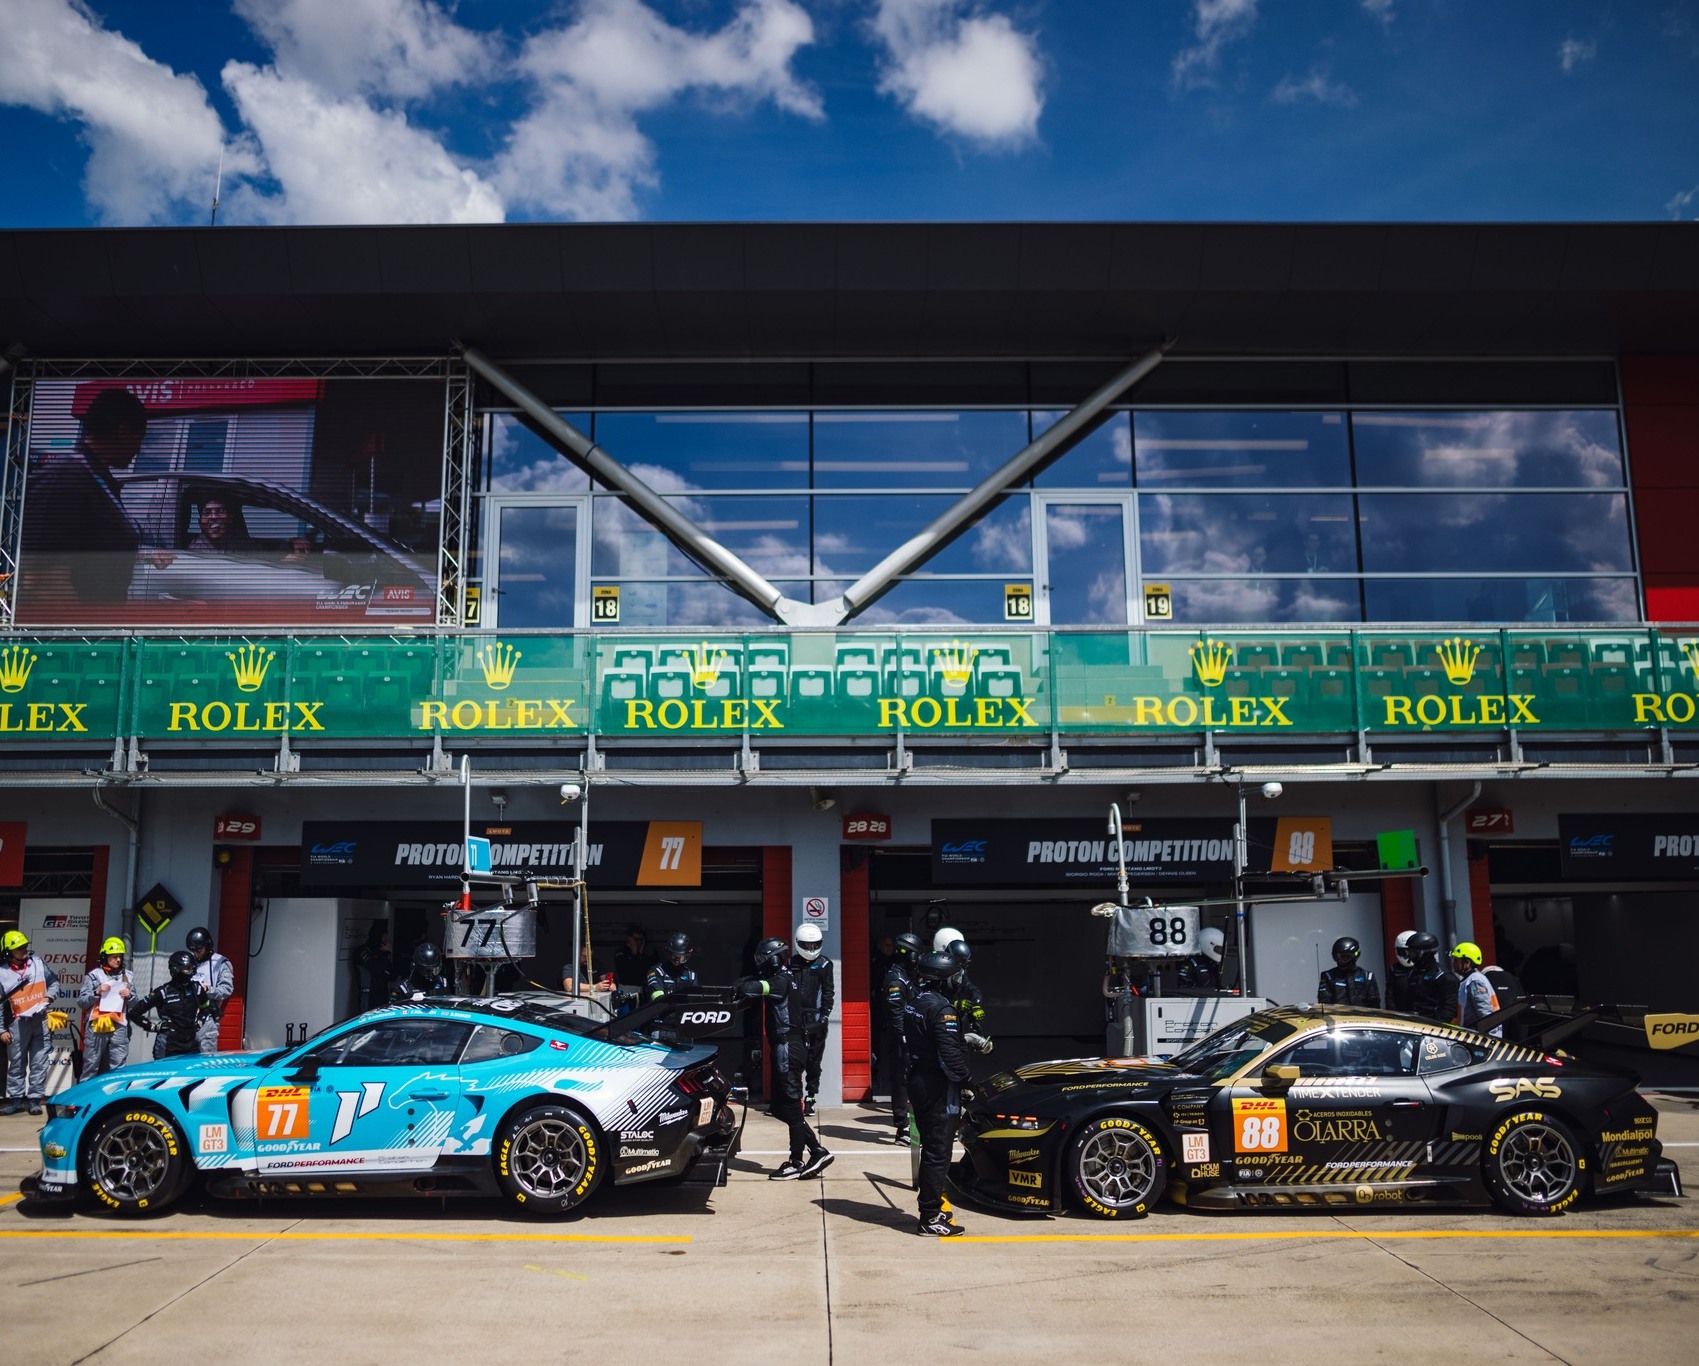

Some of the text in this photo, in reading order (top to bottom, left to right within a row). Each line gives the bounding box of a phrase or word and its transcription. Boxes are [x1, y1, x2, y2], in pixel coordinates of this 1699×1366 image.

[387, 589, 410, 600] AVIS
[596, 600, 617, 616] 18
[1008, 597, 1030, 614] 18
[1148, 597, 1169, 614] 19
[167, 702, 325, 731] ROLEX
[418, 700, 578, 730] ROLEX
[624, 699, 785, 728] ROLEX
[878, 697, 1039, 727] ROLEX
[1132, 696, 1293, 726] ROLEX
[1383, 694, 1540, 725] ROLEX
[226, 821, 256, 833] 29
[848, 821, 867, 833] 28
[869, 821, 887, 832] 28
[1472, 814, 1503, 827] 27
[659, 837, 686, 870] 77
[1027, 839, 1234, 864] PROTON COMPETITION
[1288, 832, 1315, 865] 88
[44, 920, 66, 928] GR
[1149, 917, 1187, 945] 88
[460, 919, 497, 947] 77
[44, 953, 87, 963] DENSO
[680, 1011, 731, 1024] FORD
[1652, 1022, 1699, 1036] FORD
[266, 1088, 302, 1098] DHL
[1489, 1077, 1562, 1103] SAS
[1240, 1101, 1279, 1110] DHL
[266, 1103, 299, 1136] 77
[658, 1109, 688, 1122] Milwaukee
[125, 1112, 178, 1156] GOODYEAR
[205, 1127, 222, 1138] LM
[620, 1130, 655, 1139] STALOC
[1100, 1119, 1161, 1156] GOODYEAR
[1242, 1117, 1280, 1149] 88
[1490, 1112, 1543, 1155] GOODYEAR
[1601, 1129, 1653, 1142] Mondialpol
[203, 1139, 224, 1151] GT3
[257, 1141, 321, 1154] GOODYEAR
[1188, 1135, 1203, 1147] LM
[500, 1139, 511, 1176] EAGLE
[628, 1148, 660, 1157] Multimatic
[1008, 1148, 1041, 1160] Milwaukee
[1187, 1147, 1207, 1160] GT3
[1235, 1153, 1304, 1166] GOODYEAR
[575, 1125, 597, 1196] GOODYEAR
[626, 1159, 671, 1174] GOODYEAR
[1011, 1172, 1038, 1186] VMR
[1238, 1169, 1251, 1178] FIA
[1606, 1168, 1645, 1182] GOODYEAR
[92, 1183, 120, 1208] EAGLE
[1008, 1195, 1050, 1207] GOODYEAR
[1374, 1190, 1403, 1200] robot
[1550, 1189, 1579, 1213] EAGLE
[1083, 1196, 1118, 1217] EAGLE
